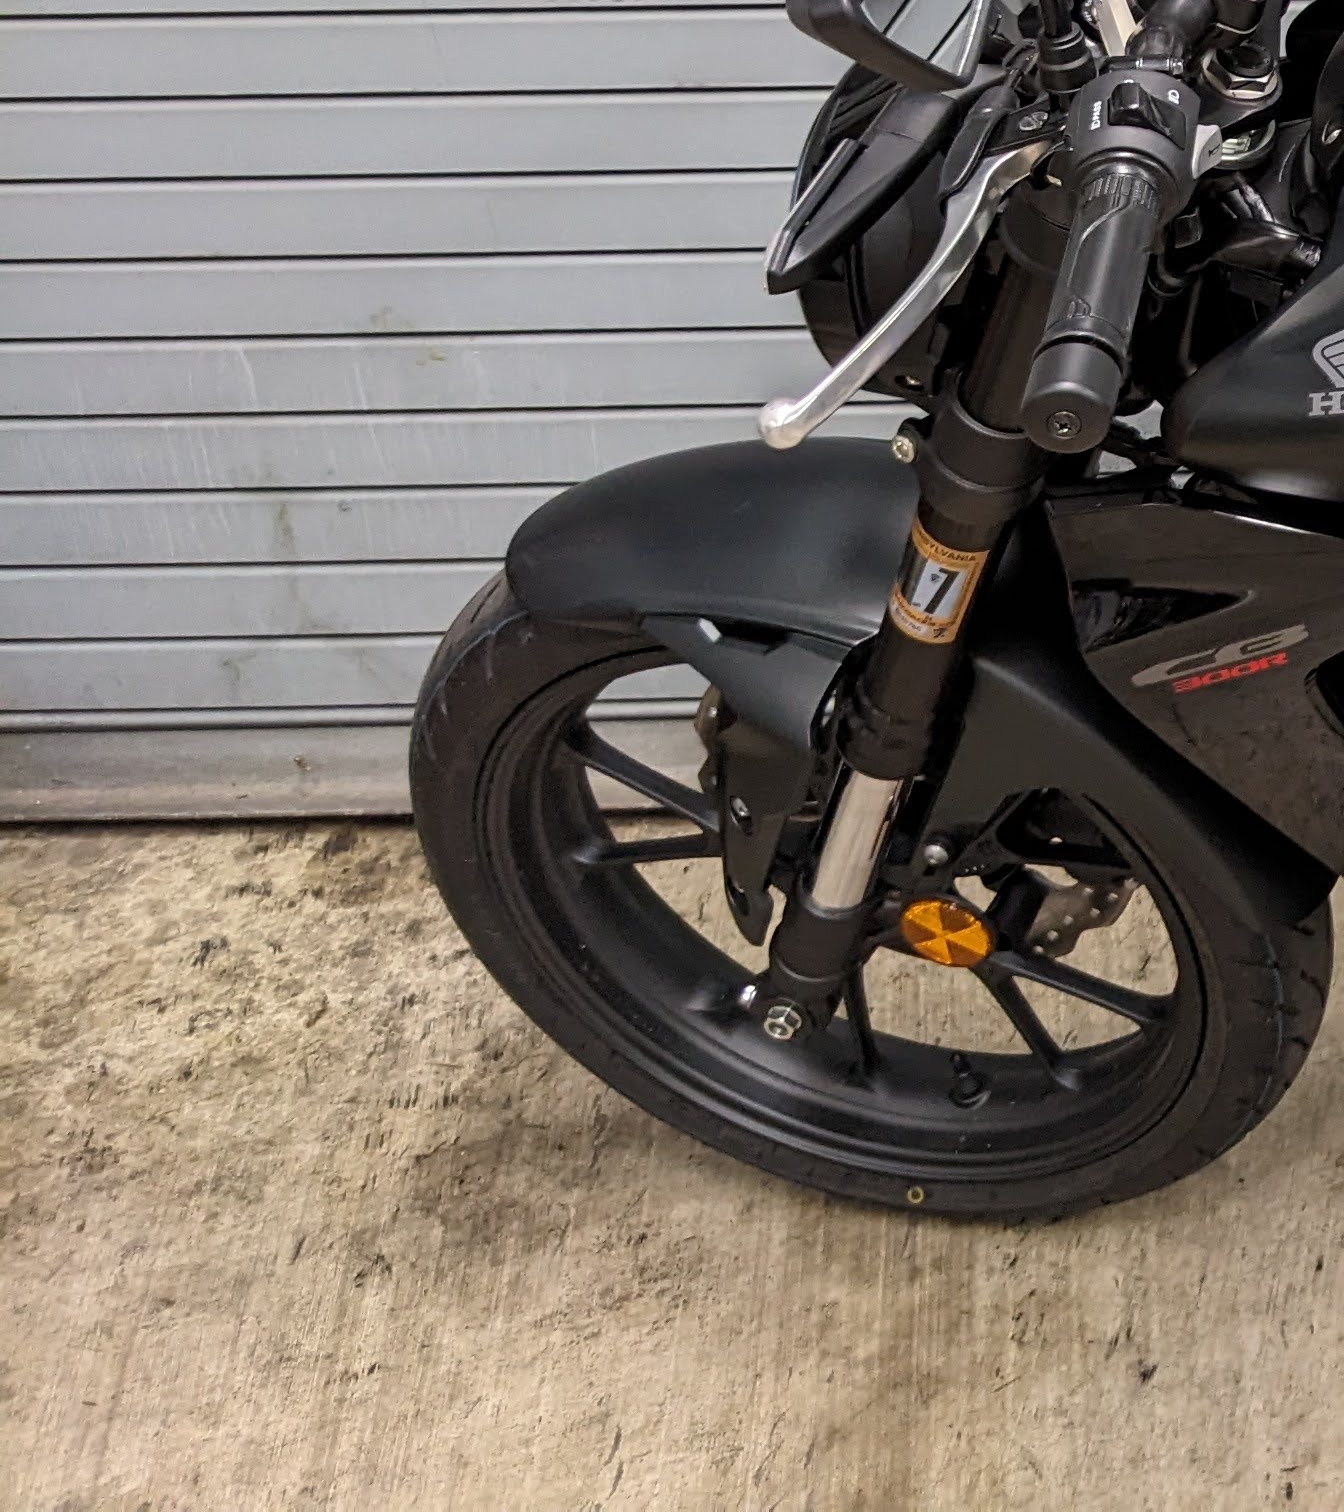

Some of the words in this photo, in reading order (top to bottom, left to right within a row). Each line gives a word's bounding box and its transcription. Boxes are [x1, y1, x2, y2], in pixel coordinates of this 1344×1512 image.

[923, 567, 961, 615] 7
[1131, 623, 1309, 687] CB
[1172, 652, 1288, 693] 300R
